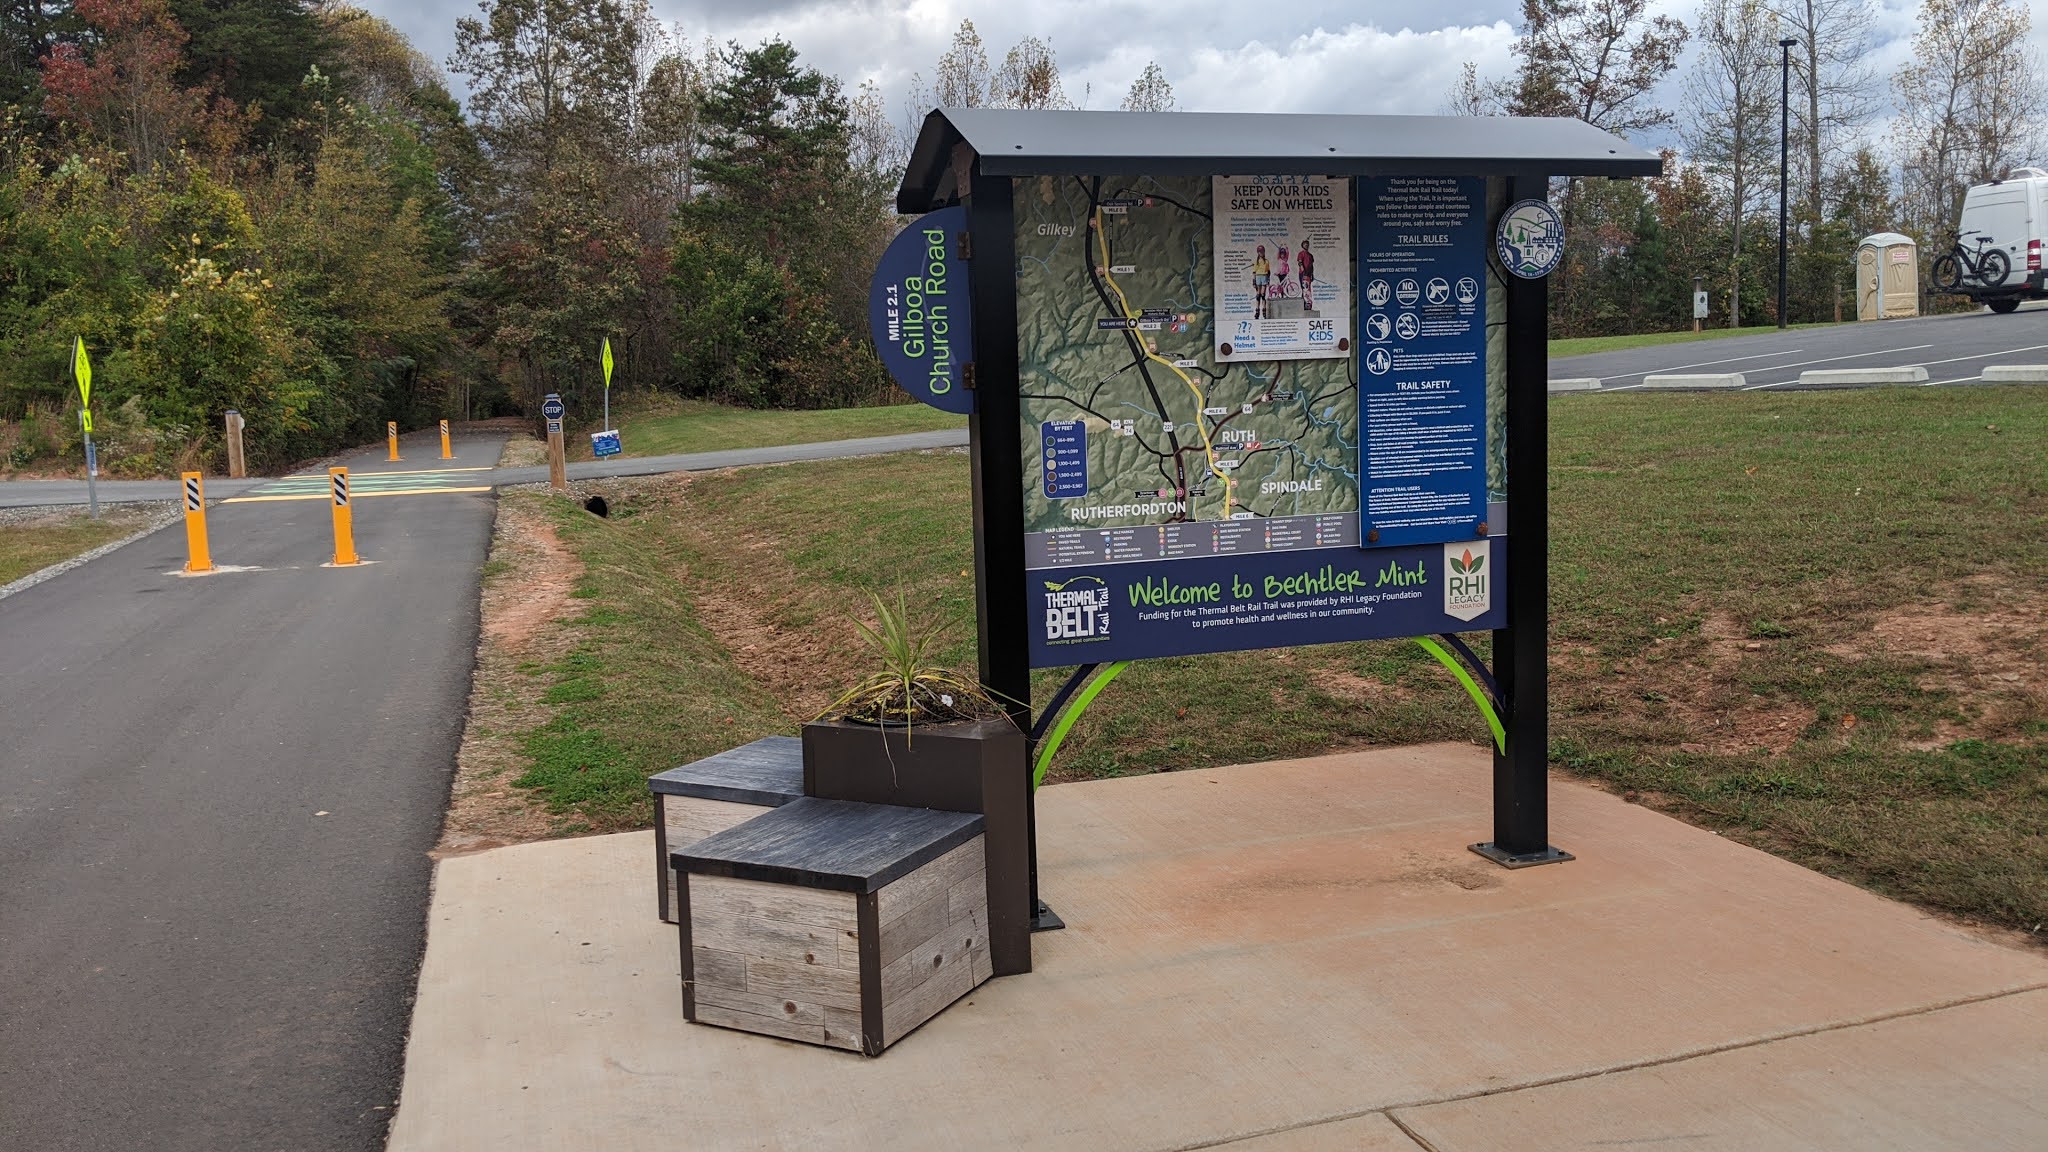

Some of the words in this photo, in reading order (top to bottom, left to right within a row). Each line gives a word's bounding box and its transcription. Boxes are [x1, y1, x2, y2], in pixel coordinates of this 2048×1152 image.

[1234, 186, 1263, 196] KEEP
[1267, 186, 1300, 196] YOUR
[1303, 186, 1329, 196] KIDS
[1231, 200, 1259, 210] SAFE
[1262, 199, 1280, 210] ON
[1284, 199, 1333, 210] WHEELS
[1037, 223, 1077, 238] Gilkey
[1398, 235, 1421, 244] TRAIL
[923, 230, 947, 295] Road
[886, 284, 898, 307] 2.1
[888, 308, 900, 341] MILE
[903, 276, 926, 358] Gilboa
[1309, 320, 1333, 330] SAFE
[927, 306, 951, 395] Church
[1396, 382, 1419, 390] TRAIL
[1421, 380, 1451, 389] SAFETY
[1222, 430, 1256, 442] RUTH
[1261, 479, 1322, 494] SPINDALE
[1071, 501, 1186, 521] RUTHERFORDTON
[1129, 576, 1221, 608] Welcome
[1232, 574, 1254, 599] to
[1375, 560, 1428, 588] Mint
[1450, 575, 1484, 596] RHI
[1045, 590, 1097, 608] THERMAL
[1097, 587, 1109, 612] Trail
[1139, 611, 1169, 620] Funding
[1171, 609, 1181, 619] for
[1198, 606, 1228, 615] Thermal
[1231, 604, 1245, 613] Belt
[1248, 602, 1261, 611] Rail
[1263, 601, 1278, 610] Trail
[1297, 598, 1328, 609] provided
[1330, 597, 1338, 606] by
[1356, 595, 1380, 604] Legacy
[1383, 590, 1422, 600] Foundation
[1450, 594, 1485, 604] LEGACY
[1046, 605, 1098, 640] BELT
[1098, 612, 1110, 635] Rail
[1203, 618, 1233, 629] promote
[1236, 615, 1259, 624] health
[1261, 614, 1274, 622] and
[1276, 610, 1308, 620] wellness
[1332, 607, 1374, 616] community.
